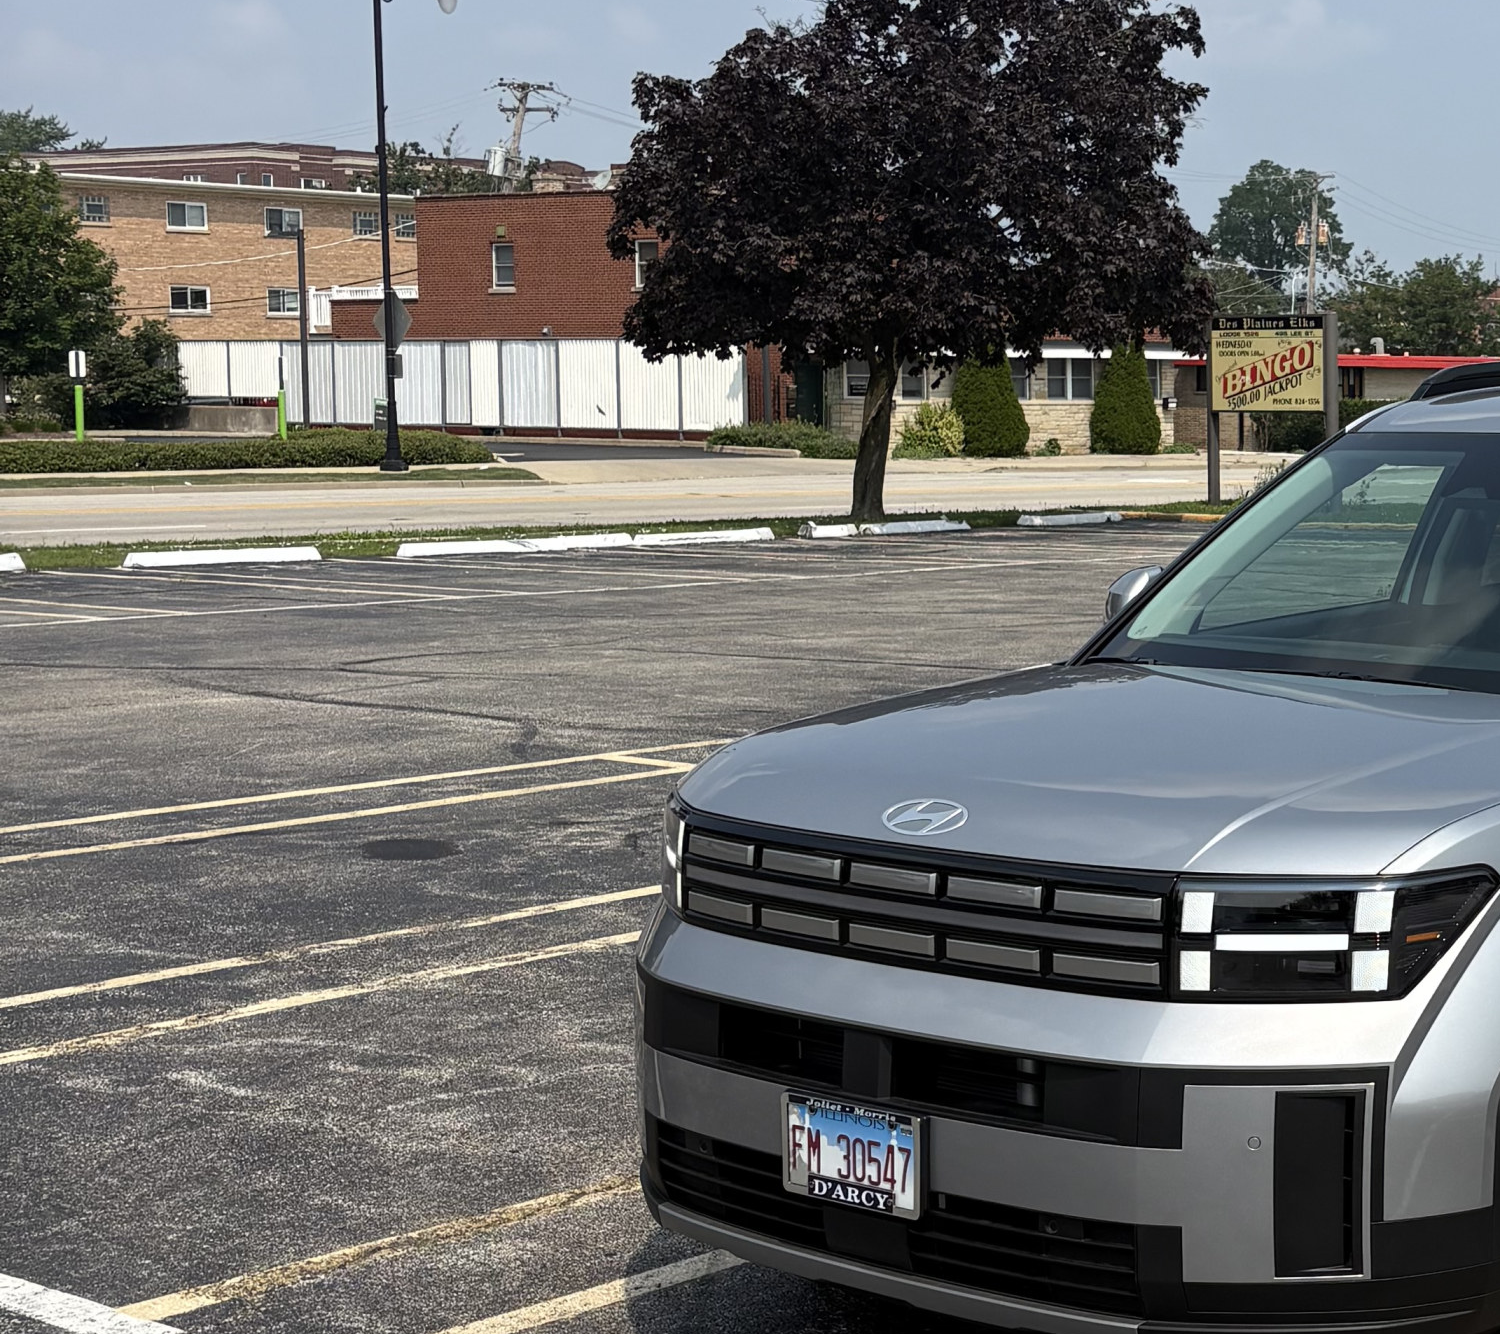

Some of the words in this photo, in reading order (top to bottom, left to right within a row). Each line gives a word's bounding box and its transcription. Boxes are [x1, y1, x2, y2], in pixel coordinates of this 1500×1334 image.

[1219, 318, 1238, 329] Des
[1243, 318, 1284, 329] Plaines
[1290, 317, 1315, 327] Elks
[1216, 340, 1253, 349] WEDNESDAY
[1224, 342, 1312, 398] BINGO
[1227, 389, 1260, 411] $500.00
[1264, 373, 1303, 401] JACKPOT
[806, 1098, 842, 1111] Joliet
[854, 1107, 896, 1122] Morris
[820, 1108, 886, 1131] ILLINOIS
[792, 1124, 821, 1175] FM
[837, 1134, 912, 1194] 30547
[813, 1179, 889, 1209] D'ARCY
